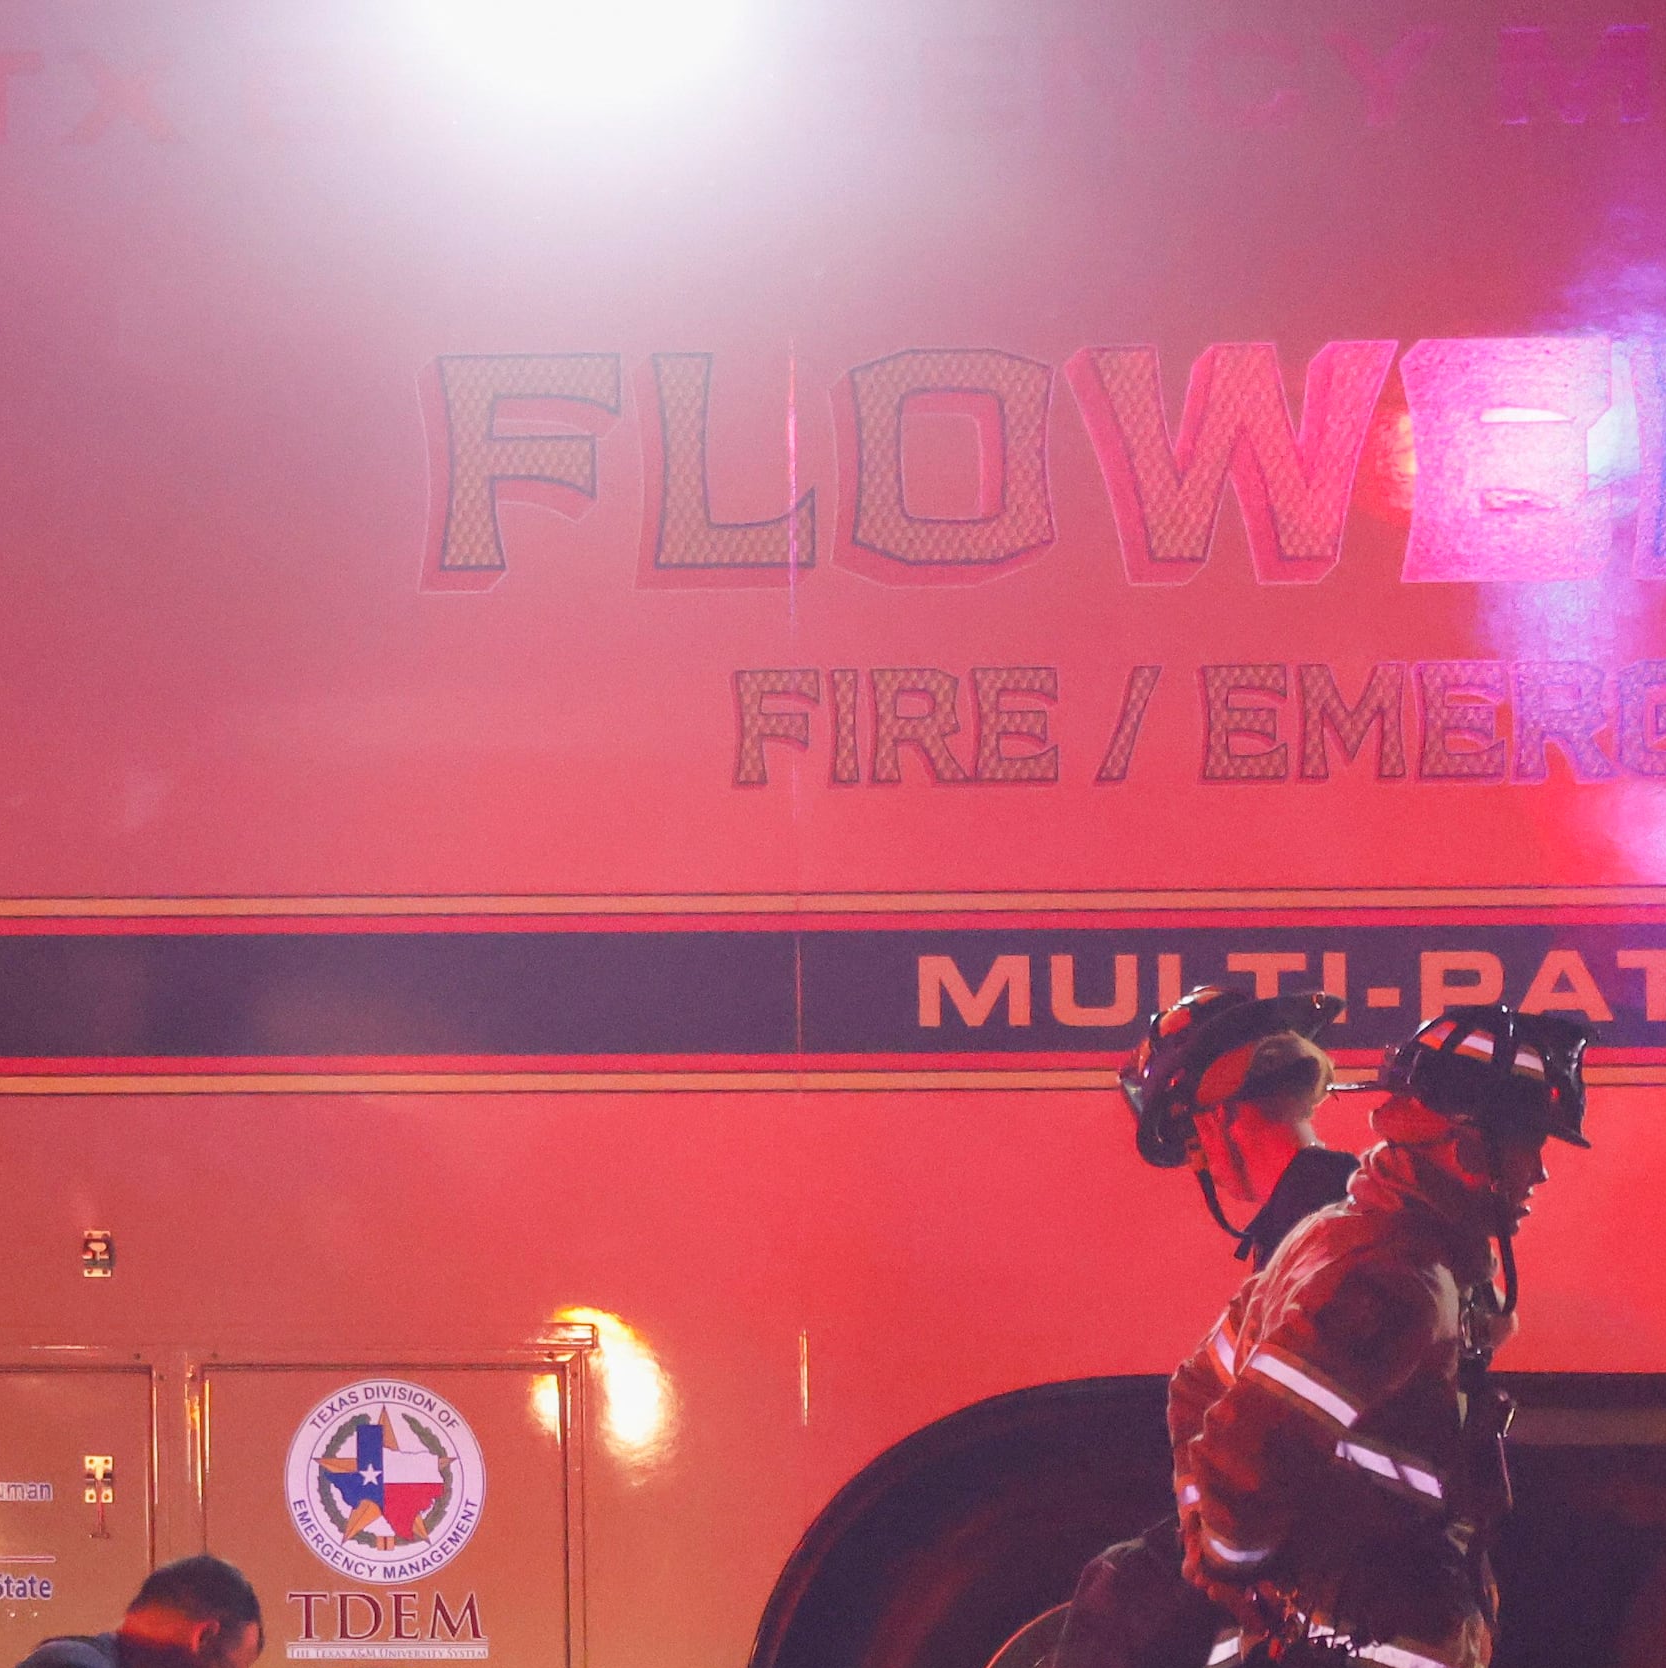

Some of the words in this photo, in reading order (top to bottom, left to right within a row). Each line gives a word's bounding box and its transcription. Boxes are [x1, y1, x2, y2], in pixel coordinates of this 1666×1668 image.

[732, 665, 1061, 790] FIRE
[308, 1390, 360, 1433] TEXAS
[363, 1384, 437, 1414] DIVISION
[437, 1408, 461, 1432] OF
[292, 1498, 379, 1579] EMERGENCY
[382, 1498, 479, 1580] MANAGEMENT
[287, 1591, 486, 1641] TDEM
